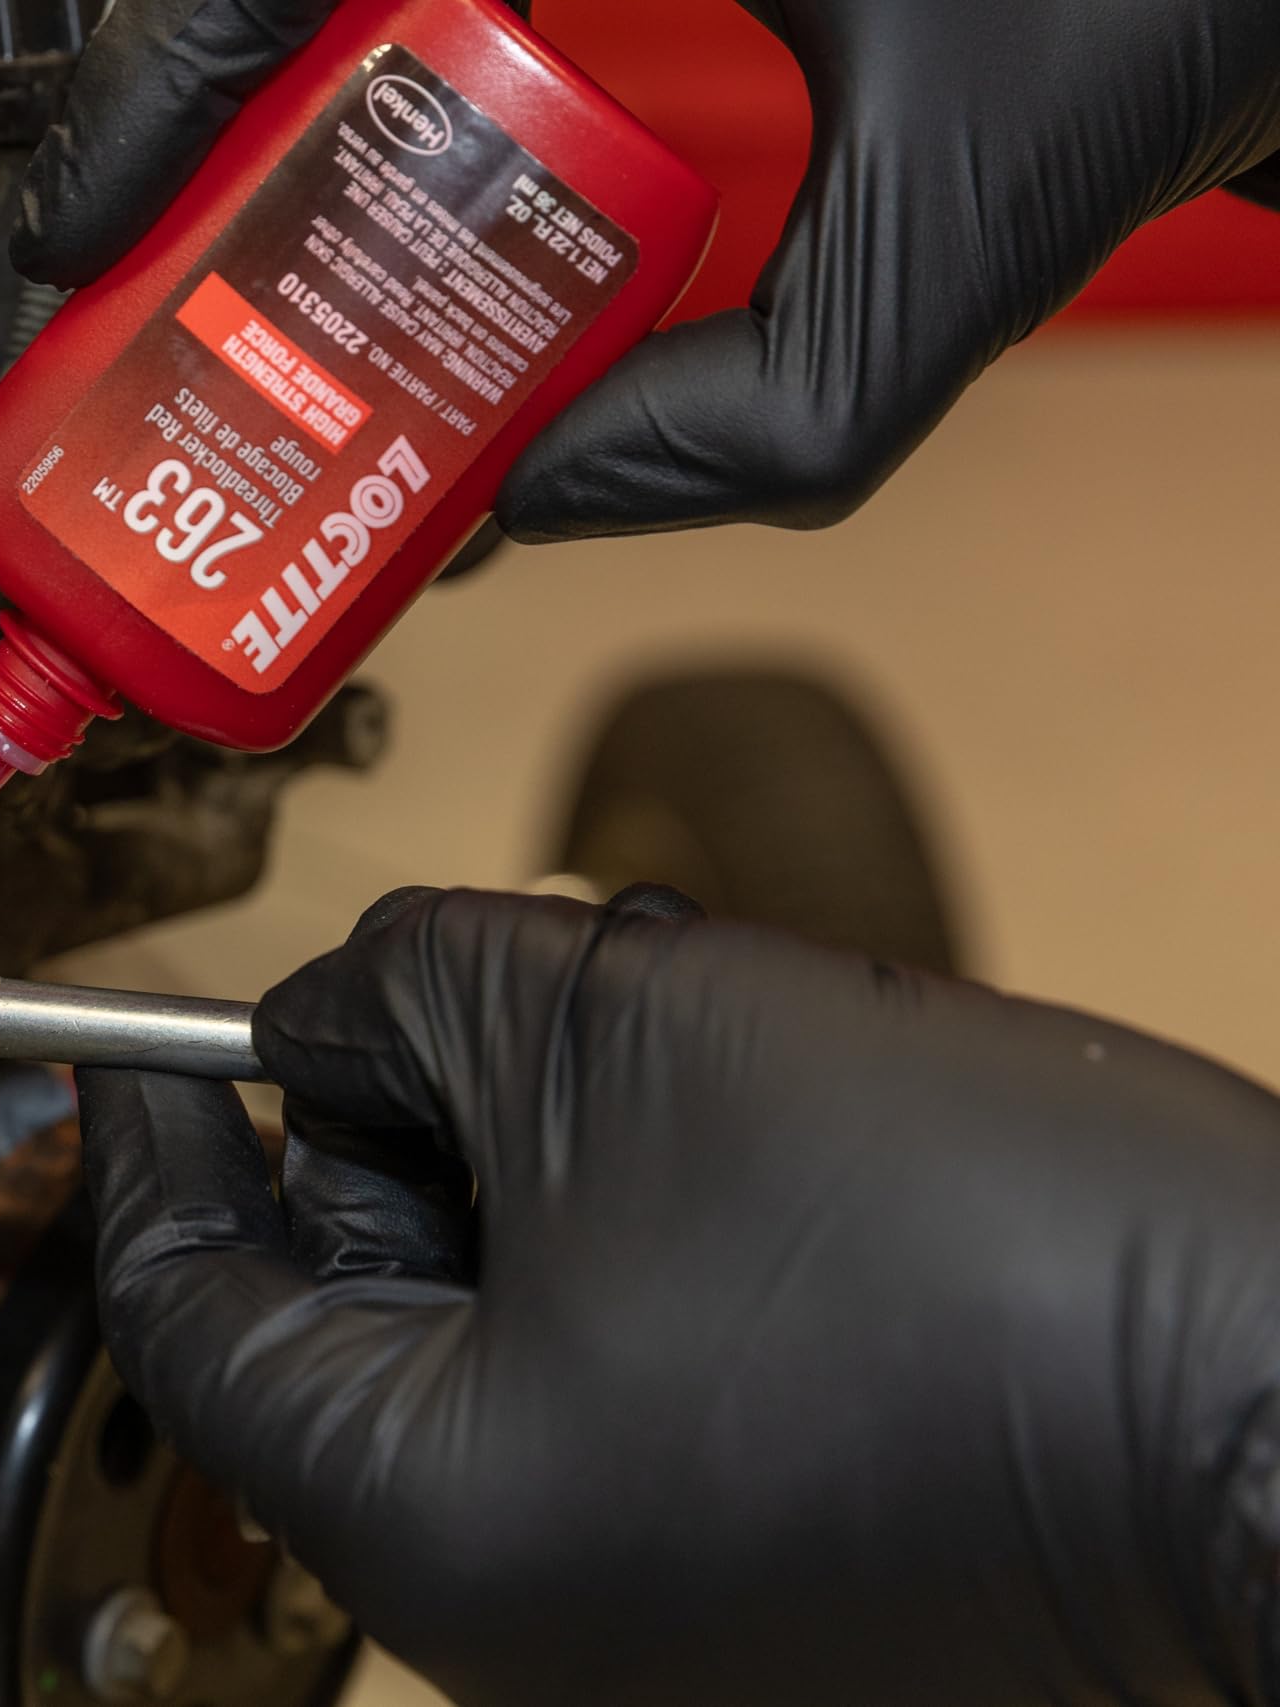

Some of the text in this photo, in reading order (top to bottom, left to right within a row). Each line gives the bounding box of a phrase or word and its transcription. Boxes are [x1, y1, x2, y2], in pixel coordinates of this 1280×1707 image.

[373, 83, 445, 150] Henkel
[333, 145, 386, 196] IRRITANT.
[364, 147, 384, 167] au
[379, 160, 417, 193] garde
[343, 180, 372, 209] UNE
[410, 187, 429, 205] en
[424, 199, 462, 234] mises
[311, 215, 343, 244] other
[366, 201, 414, 245] CAUSER
[412, 214, 434, 236] LA
[427, 227, 450, 251] DE
[456, 226, 478, 250] les
[505, 193, 609, 284] NET 1.22 FL. OZ.
[511, 173, 623, 267] POIDS NET 36 ml
[338, 237, 388, 283] carefully
[408, 238, 443, 269] PEUT
[442, 240, 512, 300] ALLERGIQUE
[472, 240, 553, 308] soigneusement
[277, 272, 369, 355] 2205310
[382, 276, 415, 308] Read
[411, 274, 450, 309] panel.
[441, 268, 548, 354] AVERTISSEMENT
[303, 233, 504, 405] WARNING: MAY CAUSE ALLERGIC SKIN
[412, 300, 467, 349] IRRITANT.
[444, 302, 475, 332] back
[470, 323, 489, 341] on
[548, 302, 573, 326] Lire
[240, 319, 362, 427] GRANDE FORCE
[367, 342, 394, 371] NO.
[221, 334, 348, 446] HIGH STRENGTH
[387, 362, 438, 406] PARTIE
[438, 404, 477, 436] PART
[144, 403, 283, 529] Threadlocker Red
[174, 387, 305, 506] Blocage de filets
[269, 435, 322, 482] rouge
[21, 445, 65, 495] 2205956
